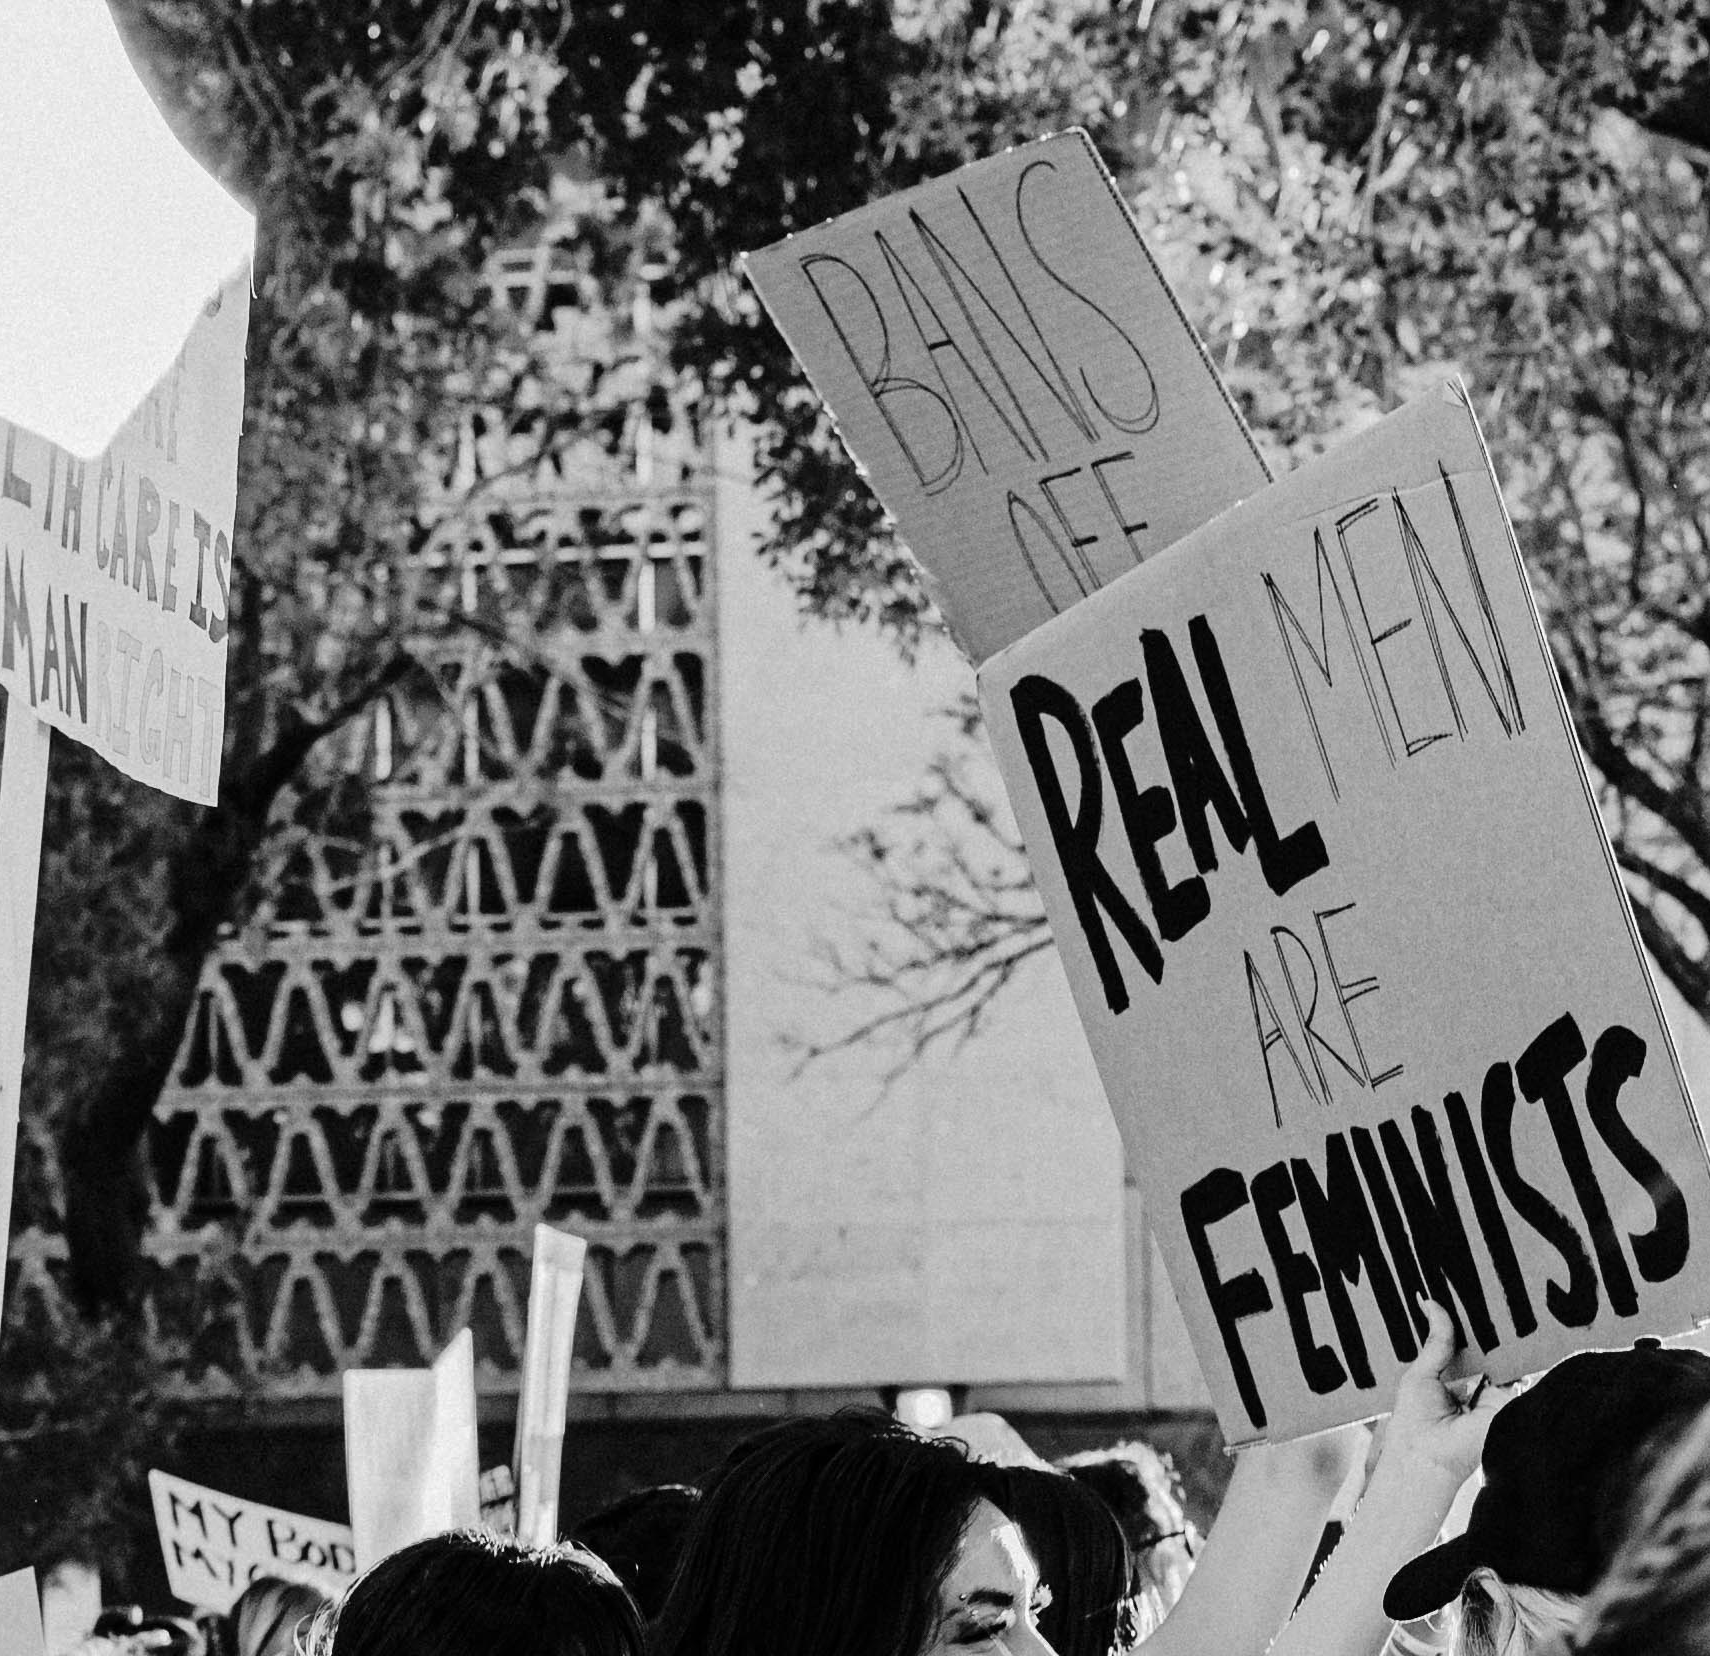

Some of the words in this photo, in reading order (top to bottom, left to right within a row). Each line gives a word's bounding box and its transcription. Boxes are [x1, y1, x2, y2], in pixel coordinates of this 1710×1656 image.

[798, 158, 1162, 498] BANS
[95, 620, 223, 799] RIGHT
[1009, 613, 1330, 1012] REAL
[1260, 459, 1526, 801] MEN
[1243, 903, 1404, 1129] ARE
[1179, 1011, 1692, 1429] FEMINISTS
[169, 1491, 244, 1548] MY
